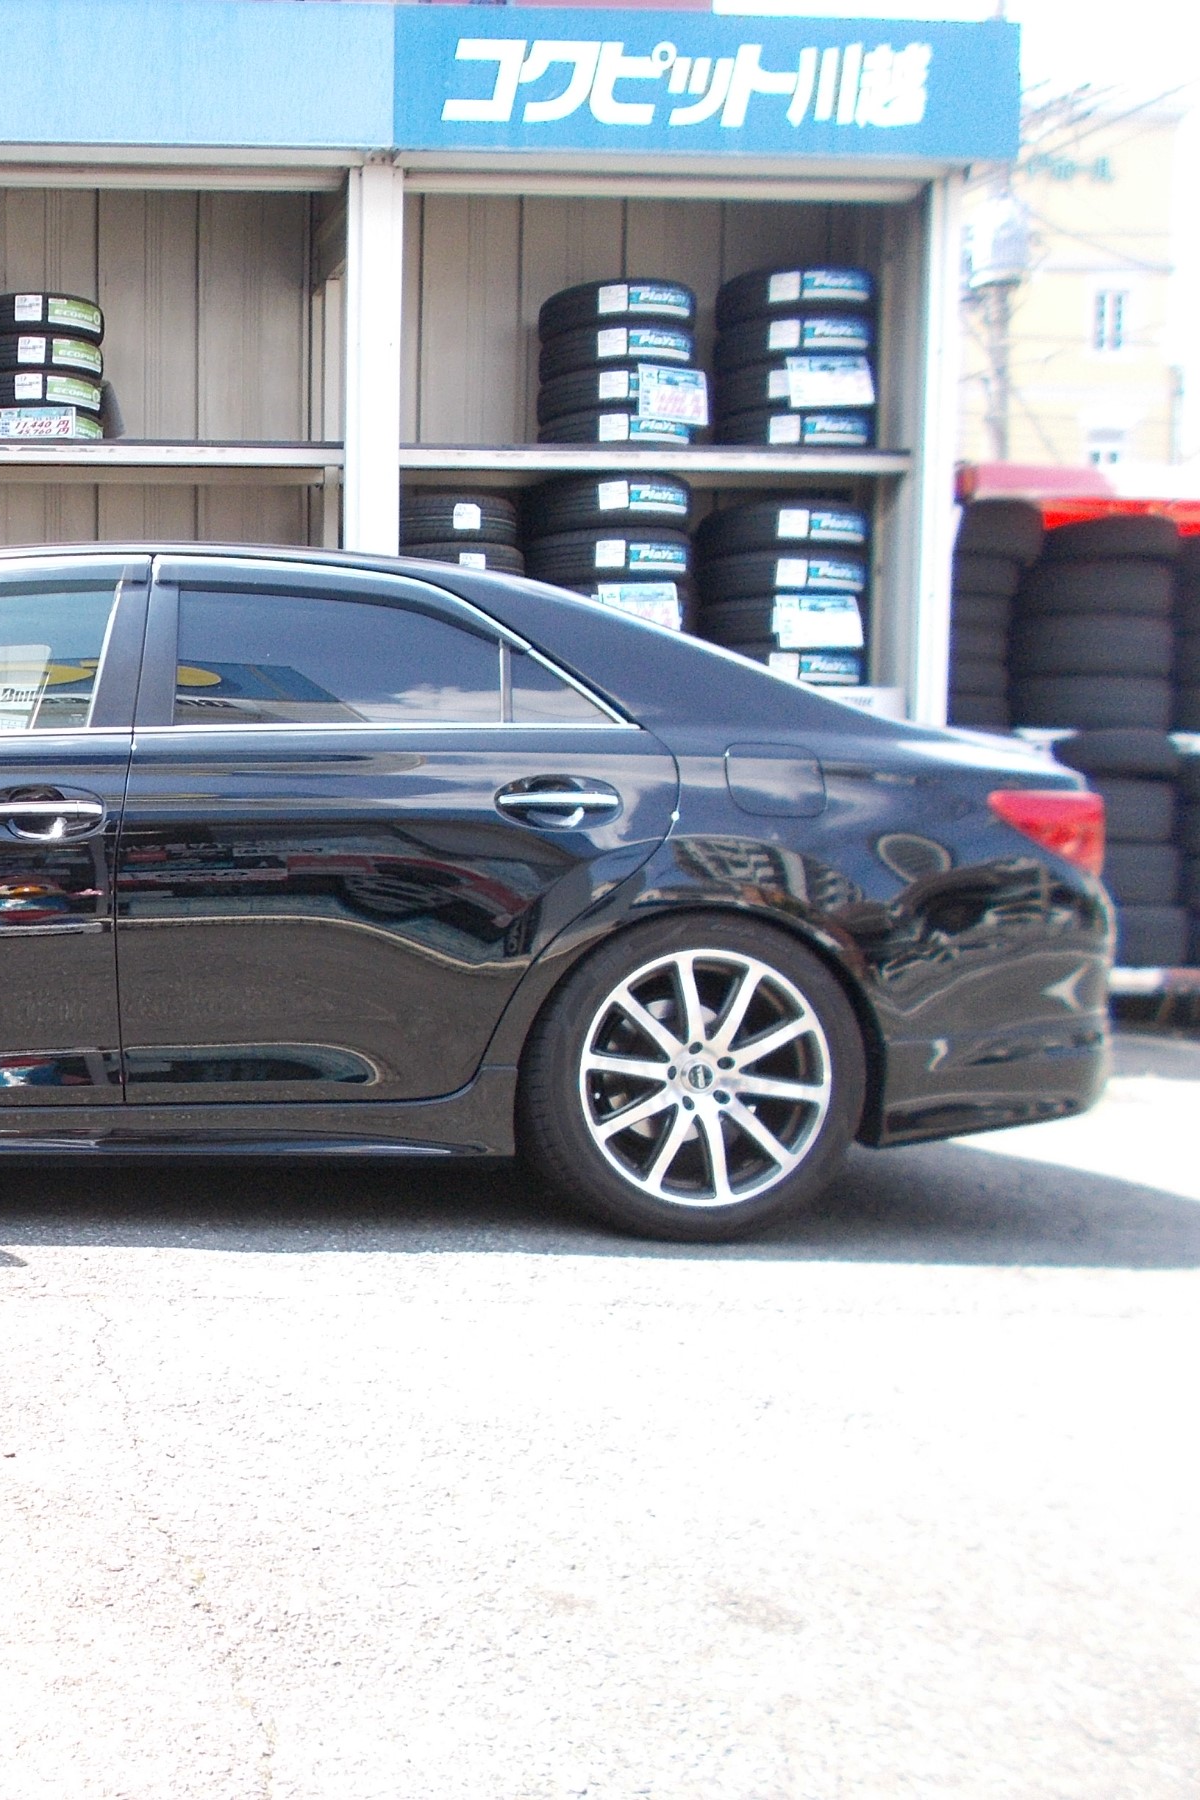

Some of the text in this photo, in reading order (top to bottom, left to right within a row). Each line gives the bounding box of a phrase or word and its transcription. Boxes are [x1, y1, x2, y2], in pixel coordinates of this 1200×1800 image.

[441, 38, 932, 127] コクピット川越
